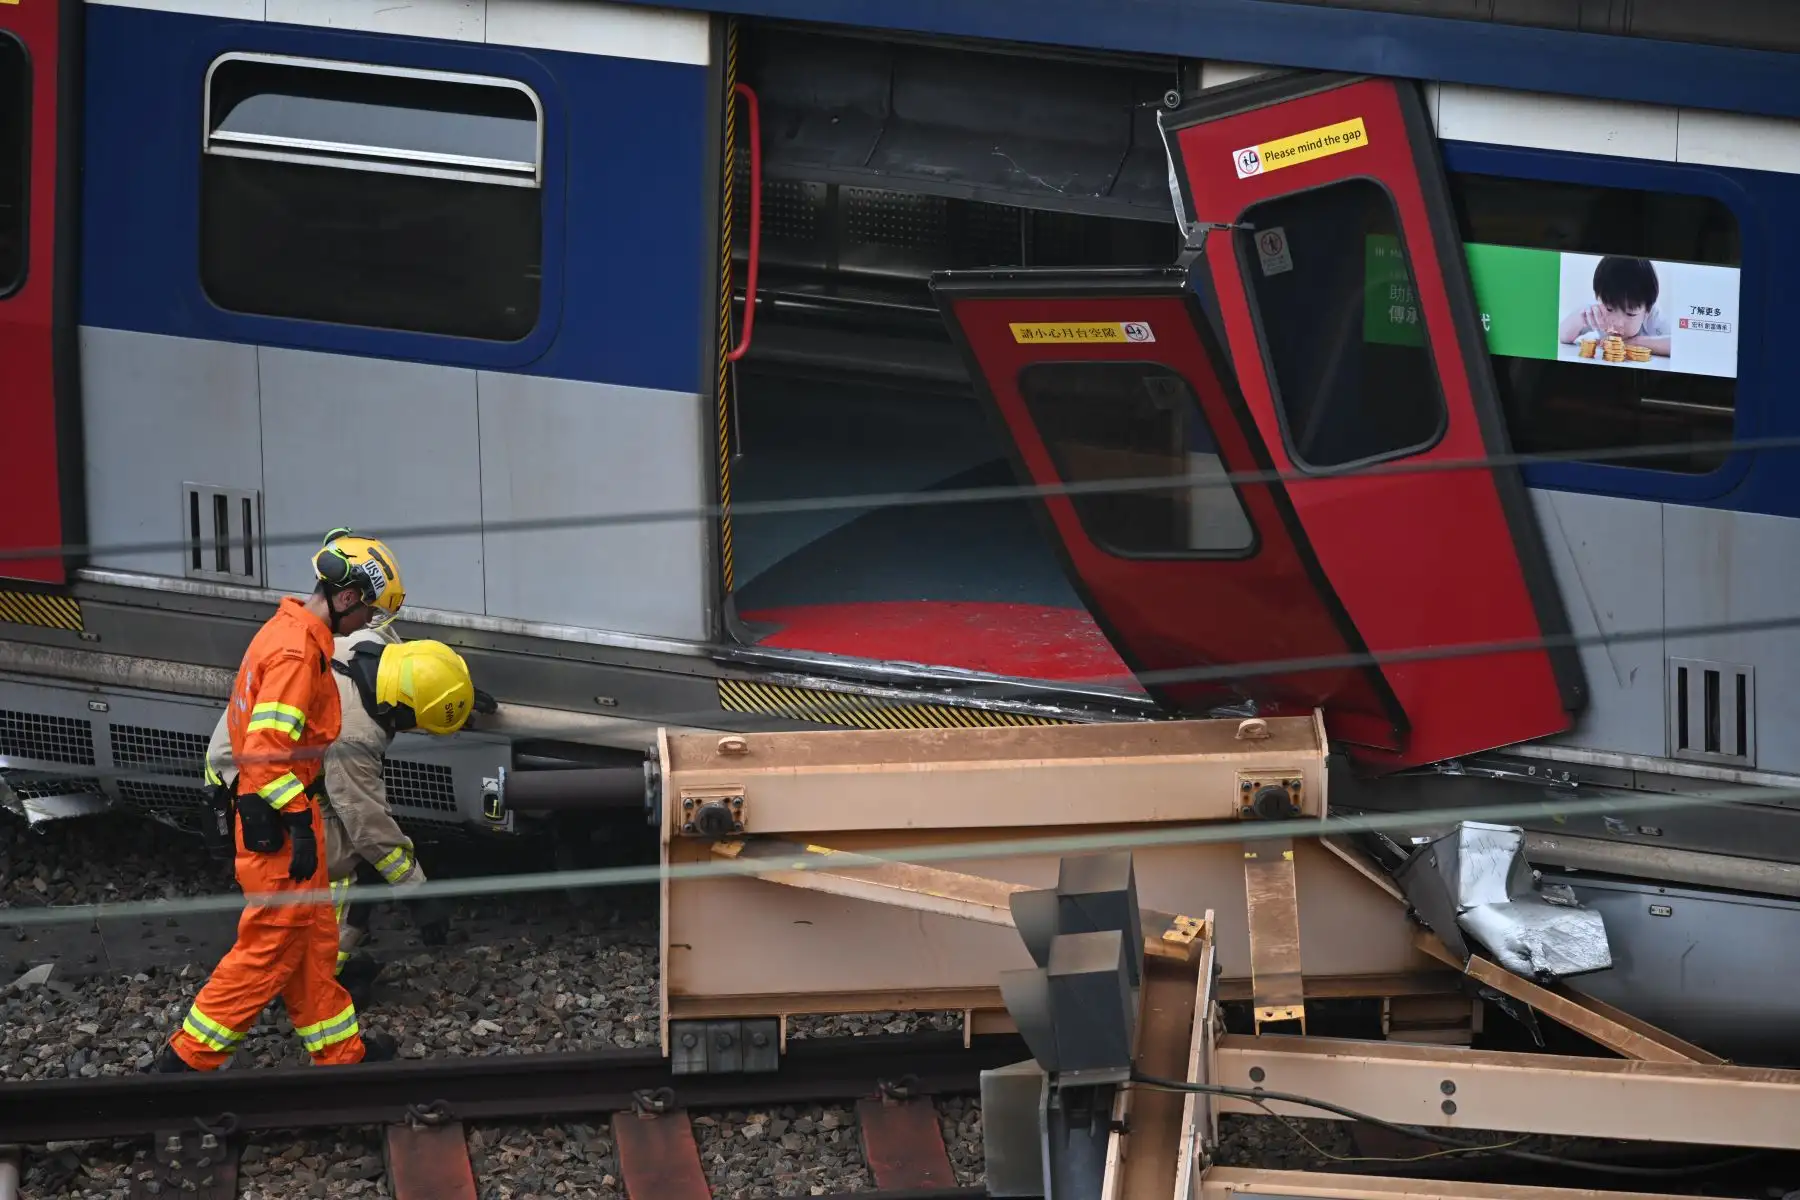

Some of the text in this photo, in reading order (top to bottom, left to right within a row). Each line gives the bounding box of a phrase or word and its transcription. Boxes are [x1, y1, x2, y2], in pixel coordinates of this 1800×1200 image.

[1264, 129, 1362, 162] Please mind the gap
[1690, 305, 1722, 317] 了解更多
[1019, 327, 1117, 339] 請小心月台空隙
[364, 560, 386, 591] USAR
